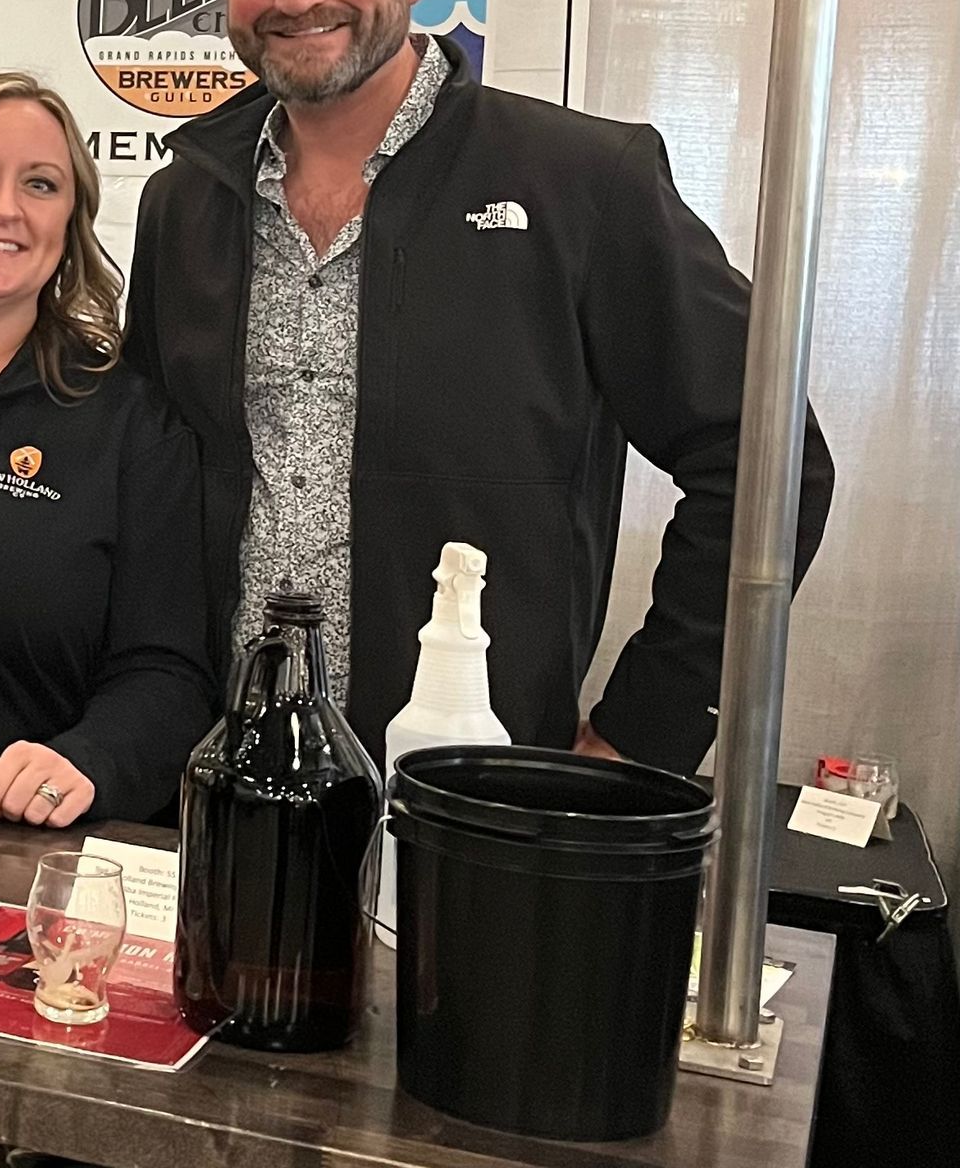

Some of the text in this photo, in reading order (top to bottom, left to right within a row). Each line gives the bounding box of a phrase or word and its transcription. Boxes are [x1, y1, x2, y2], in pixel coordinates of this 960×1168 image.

[98, 50, 141, 61] GRAND
[148, 50, 196, 61] RAPIDS
[118, 70, 247, 90] BREWERS
[150, 92, 212, 103] GUILD
[485, 201, 507, 213] THE
[465, 210, 506, 223] NORTH
[476, 219, 507, 231] FACE
[6, 473, 61, 501] HOLLAND
